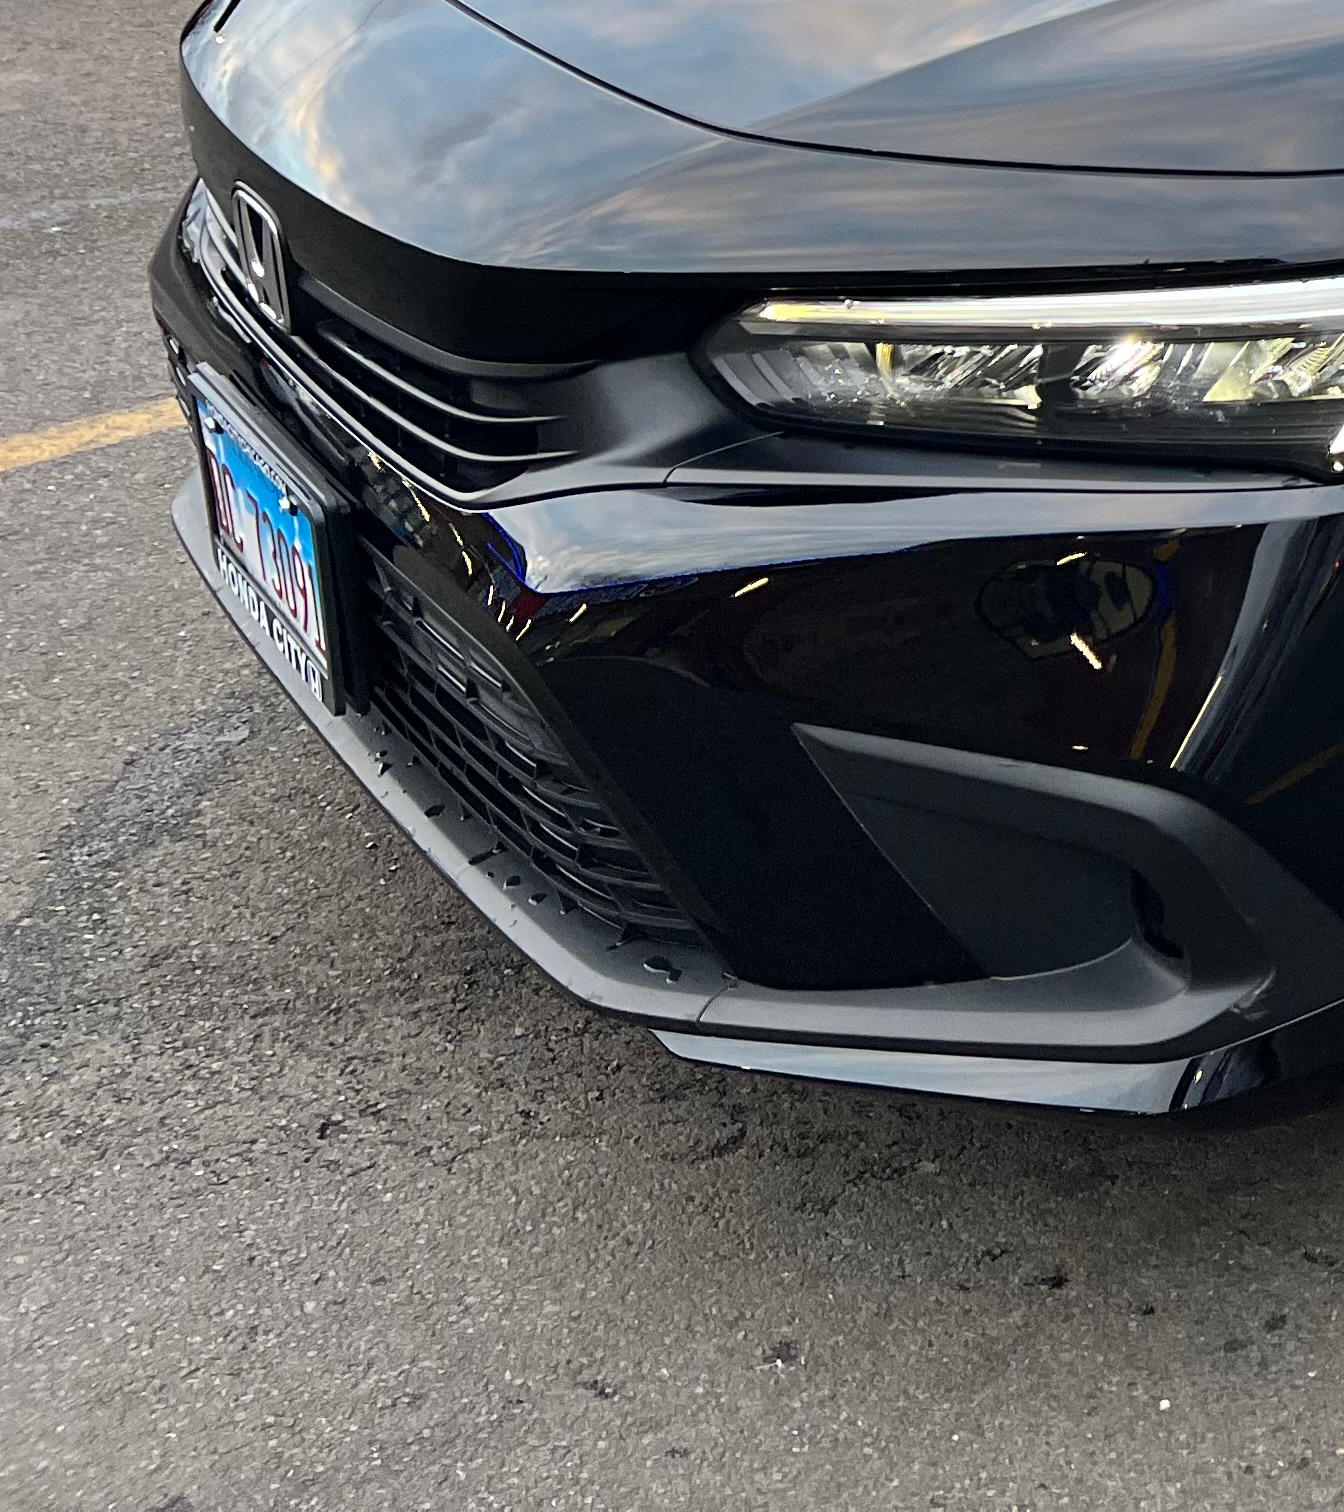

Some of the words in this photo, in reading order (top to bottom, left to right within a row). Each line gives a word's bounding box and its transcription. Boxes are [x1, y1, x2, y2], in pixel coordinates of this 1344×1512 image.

[217, 547, 271, 637] HONDA
[272, 618, 309, 683] CITY
[246, 489, 327, 653] 73091
